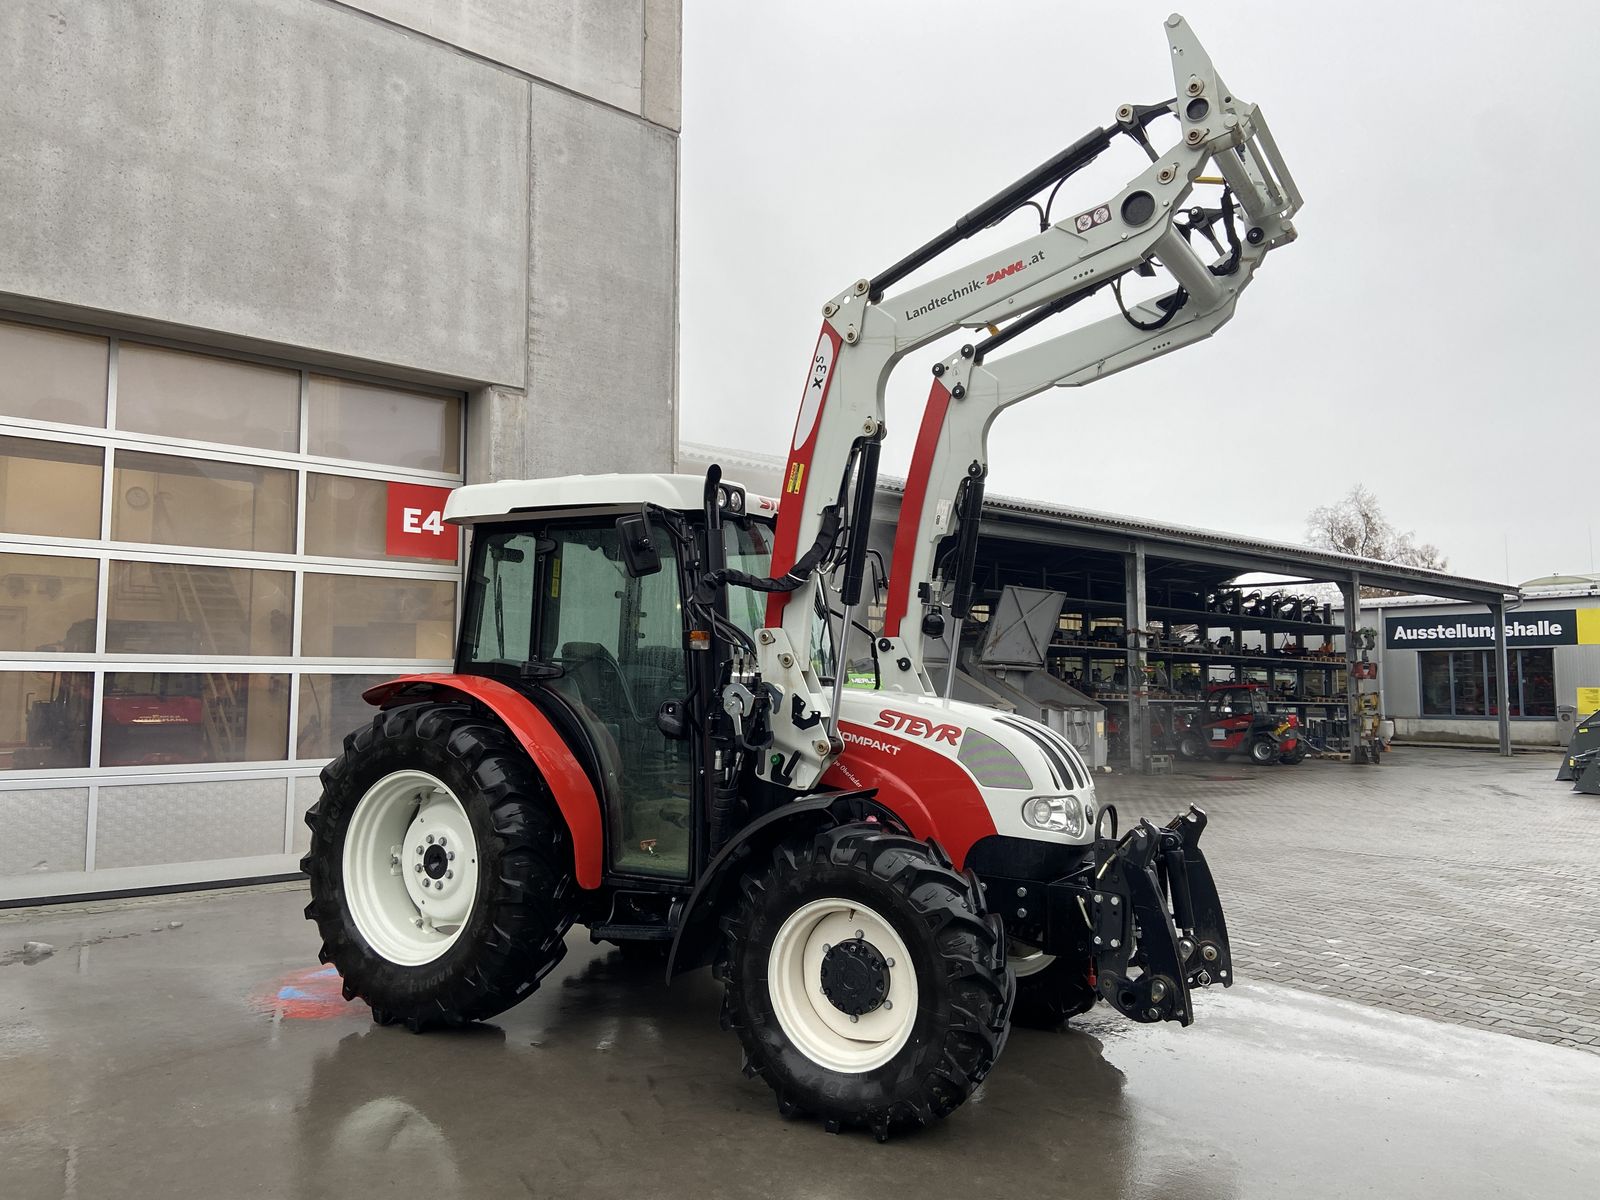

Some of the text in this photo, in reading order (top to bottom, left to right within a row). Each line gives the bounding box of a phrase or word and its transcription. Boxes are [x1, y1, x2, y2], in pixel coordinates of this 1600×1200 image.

[403, 507, 445, 536] E4
[873, 709, 962, 747] STEYR
[840, 730, 901, 756] OMPAKT
